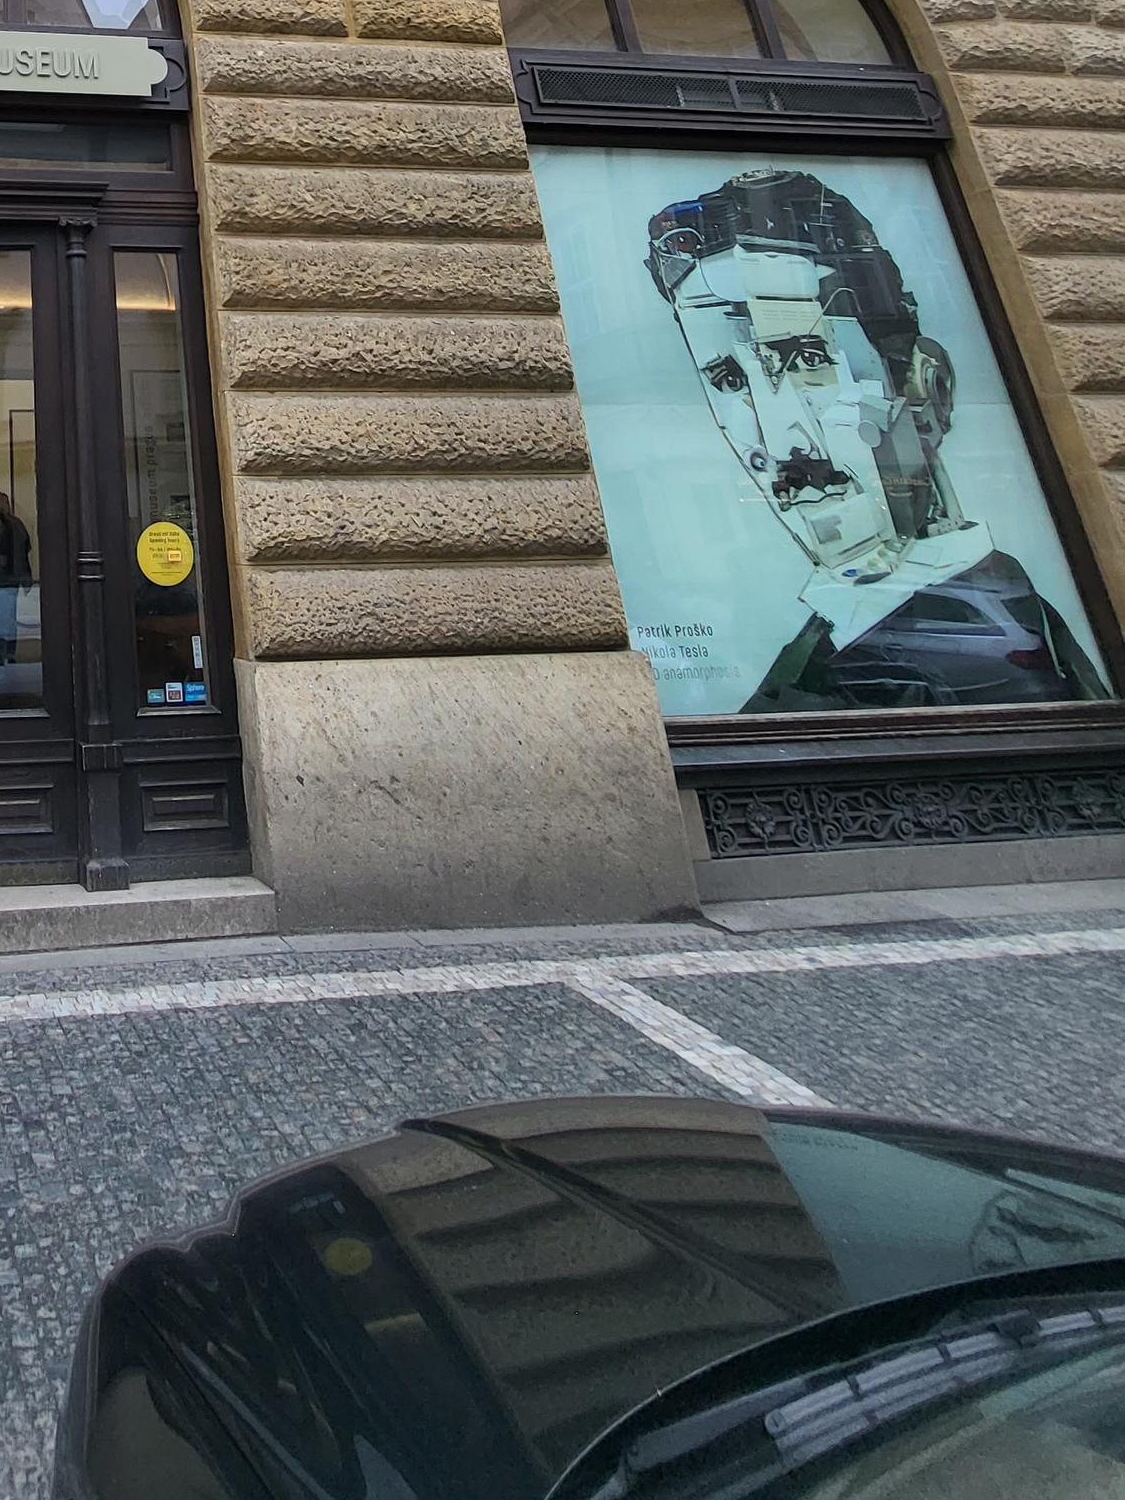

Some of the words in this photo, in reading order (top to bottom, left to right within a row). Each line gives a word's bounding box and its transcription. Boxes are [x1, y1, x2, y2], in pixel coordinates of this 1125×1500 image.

[637, 624, 672, 638] Patrik
[675, 623, 713, 637] Proško
[679, 644, 709, 658] Tesla
